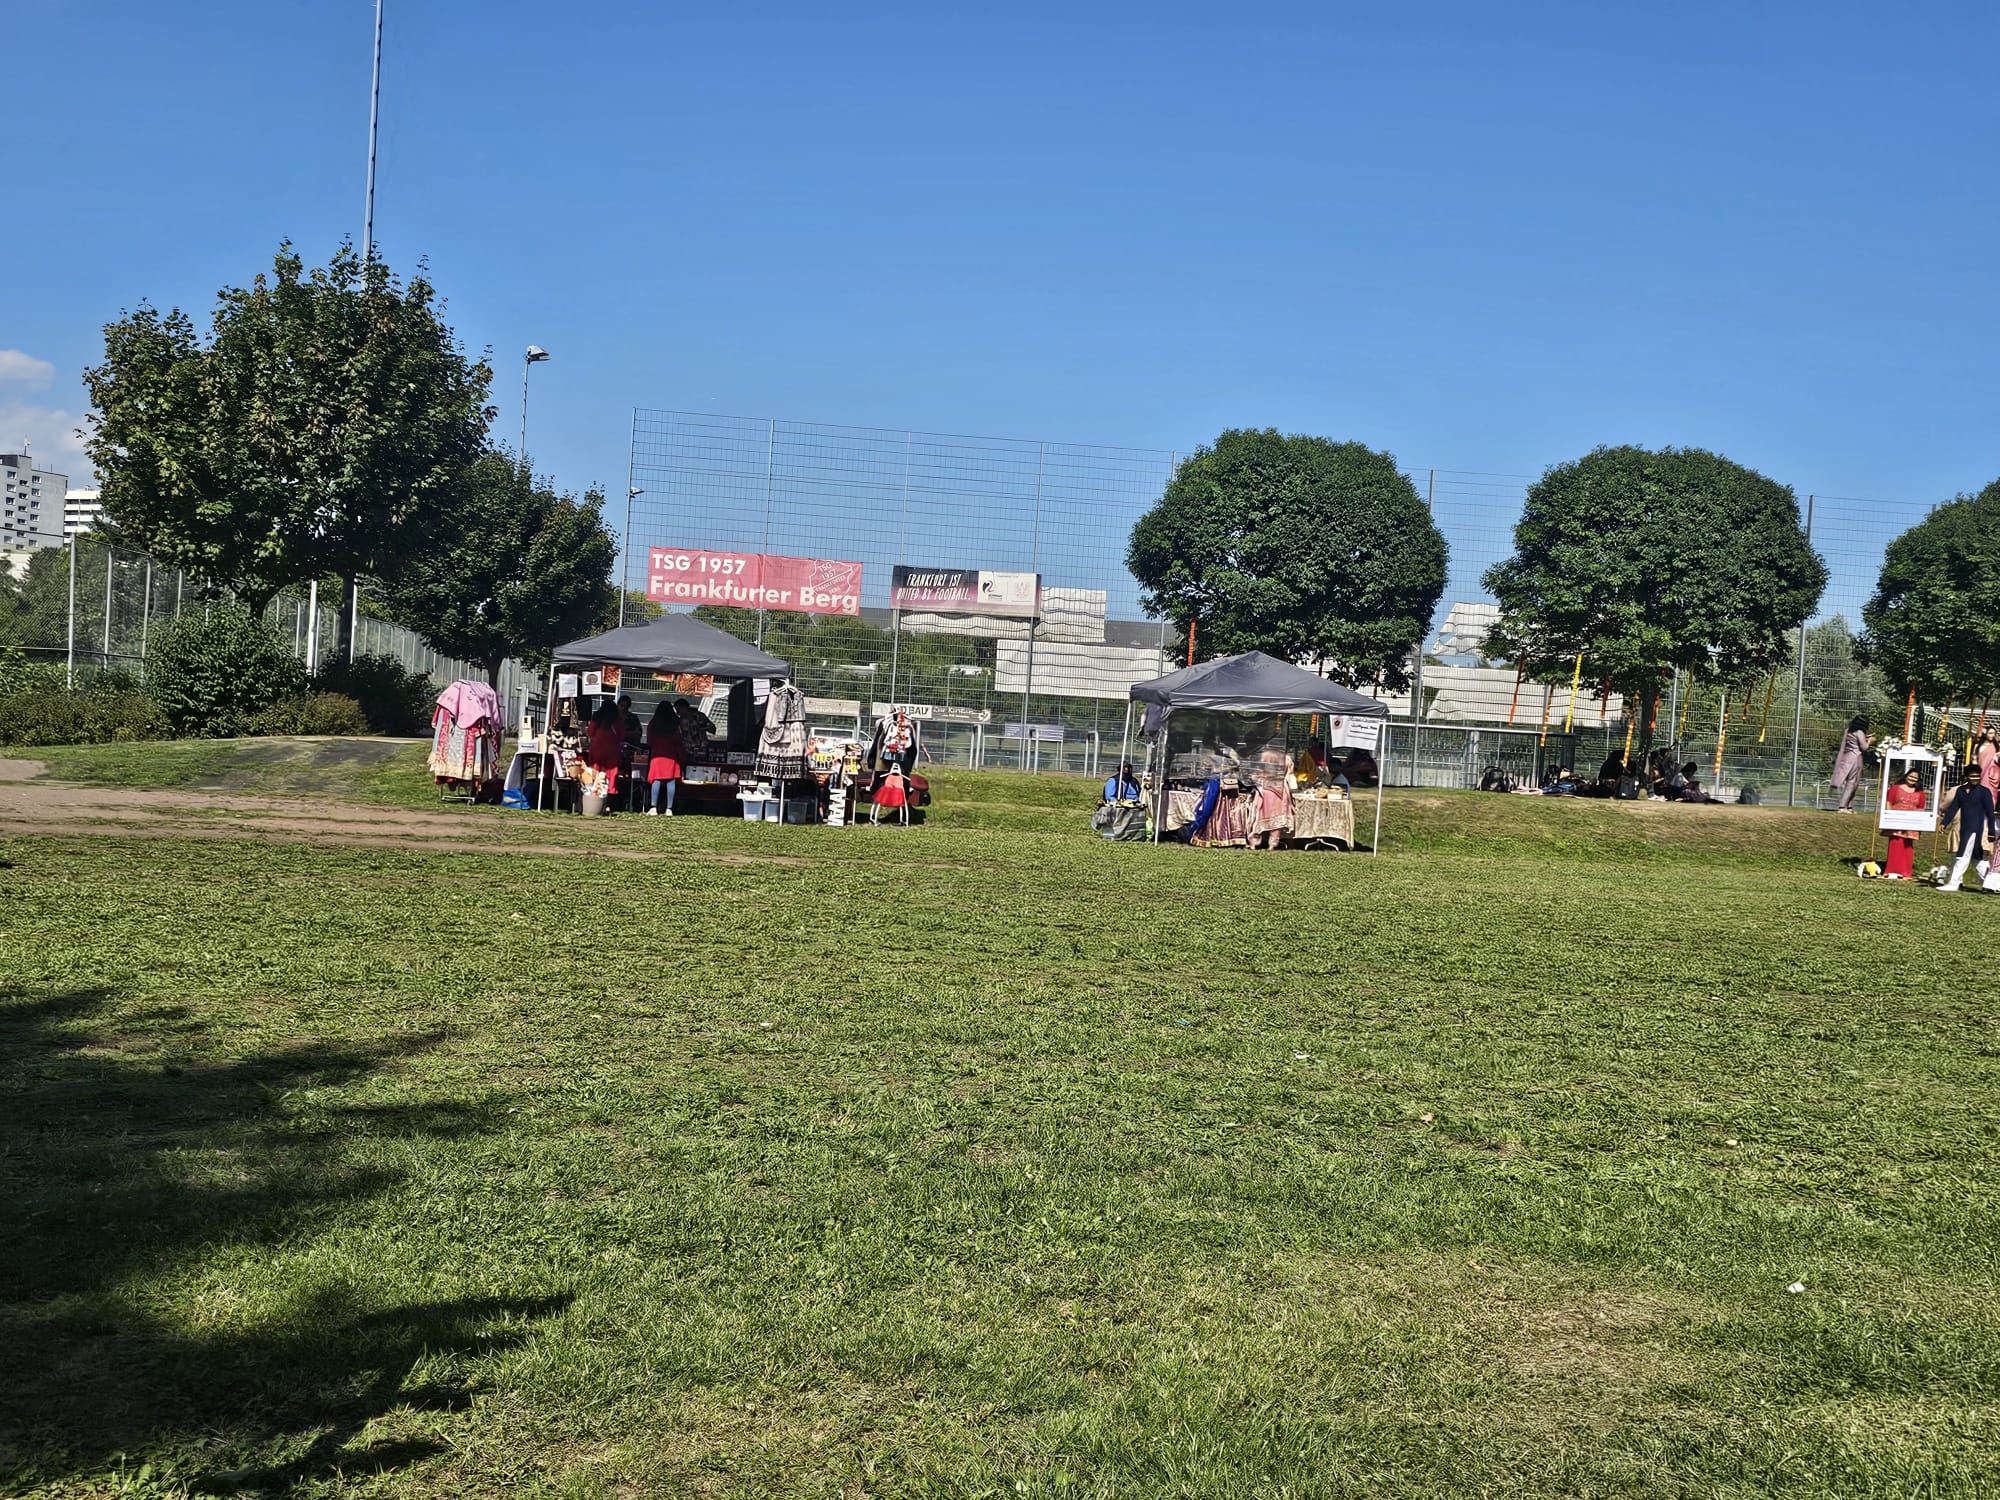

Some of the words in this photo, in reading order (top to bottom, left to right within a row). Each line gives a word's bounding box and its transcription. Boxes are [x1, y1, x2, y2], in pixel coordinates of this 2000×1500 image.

[652, 553, 691, 571] TSG
[699, 557, 746, 575] 1957
[817, 561, 833, 573] TSG
[820, 568, 837, 581] 1957
[906, 573, 948, 587] FRANKFURT
[948, 573, 962, 587] IST
[650, 575, 792, 604] Frankfurter
[799, 586, 857, 615] Berg
[896, 587, 920, 600] UNITED
[922, 587, 934, 600] BY
[934, 587, 971, 601] FOOTBALL.
